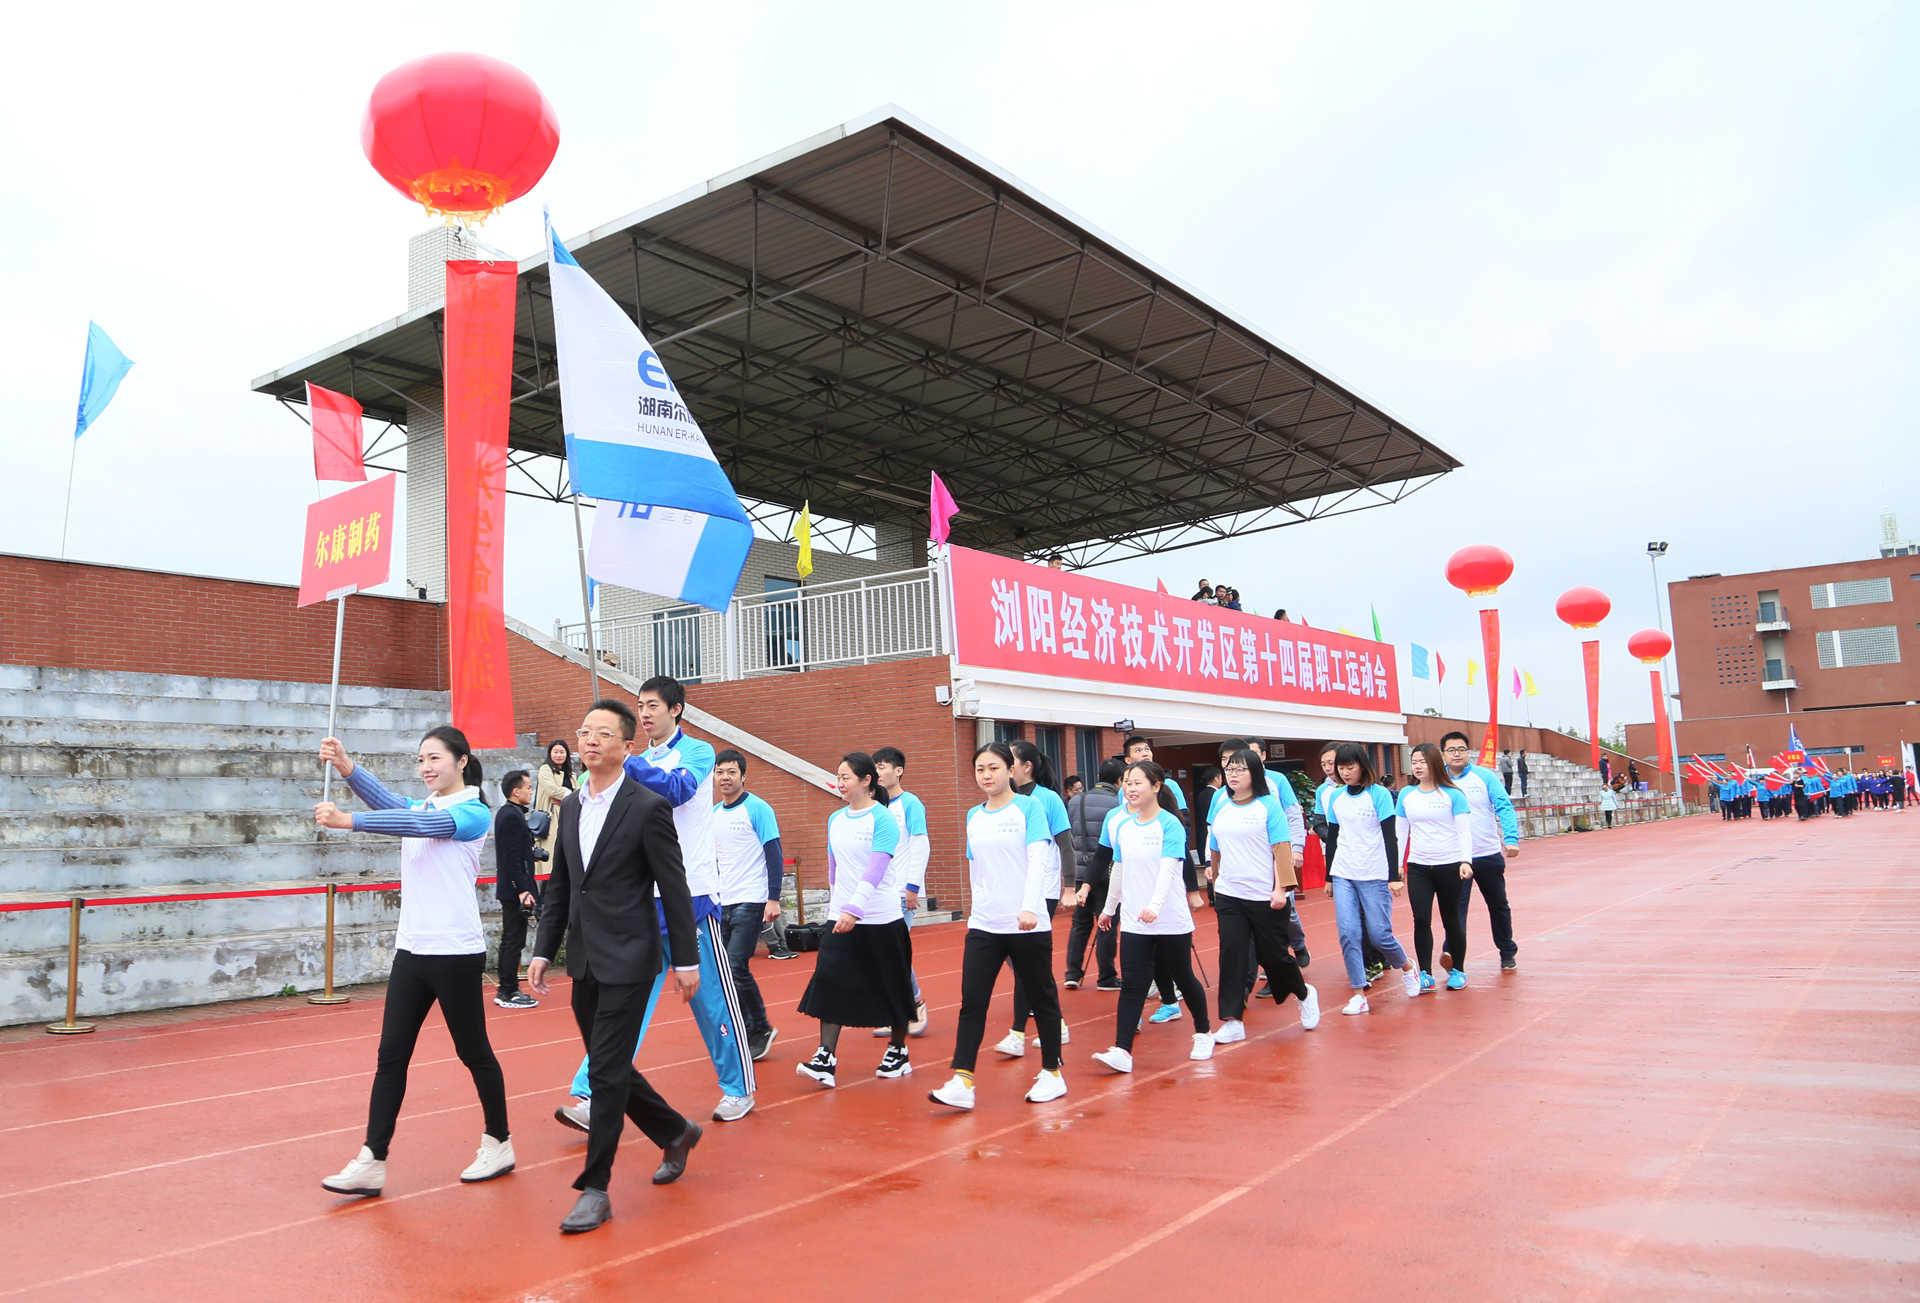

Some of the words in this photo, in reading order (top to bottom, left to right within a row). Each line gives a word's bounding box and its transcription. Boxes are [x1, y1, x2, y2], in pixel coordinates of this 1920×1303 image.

[637, 349, 675, 393] E
[637, 422, 673, 438] HUNAN
[314, 511, 381, 569] 尔康制药
[990, 577, 1388, 700] 浏阳经济技术开发区第十四届职工运动会
